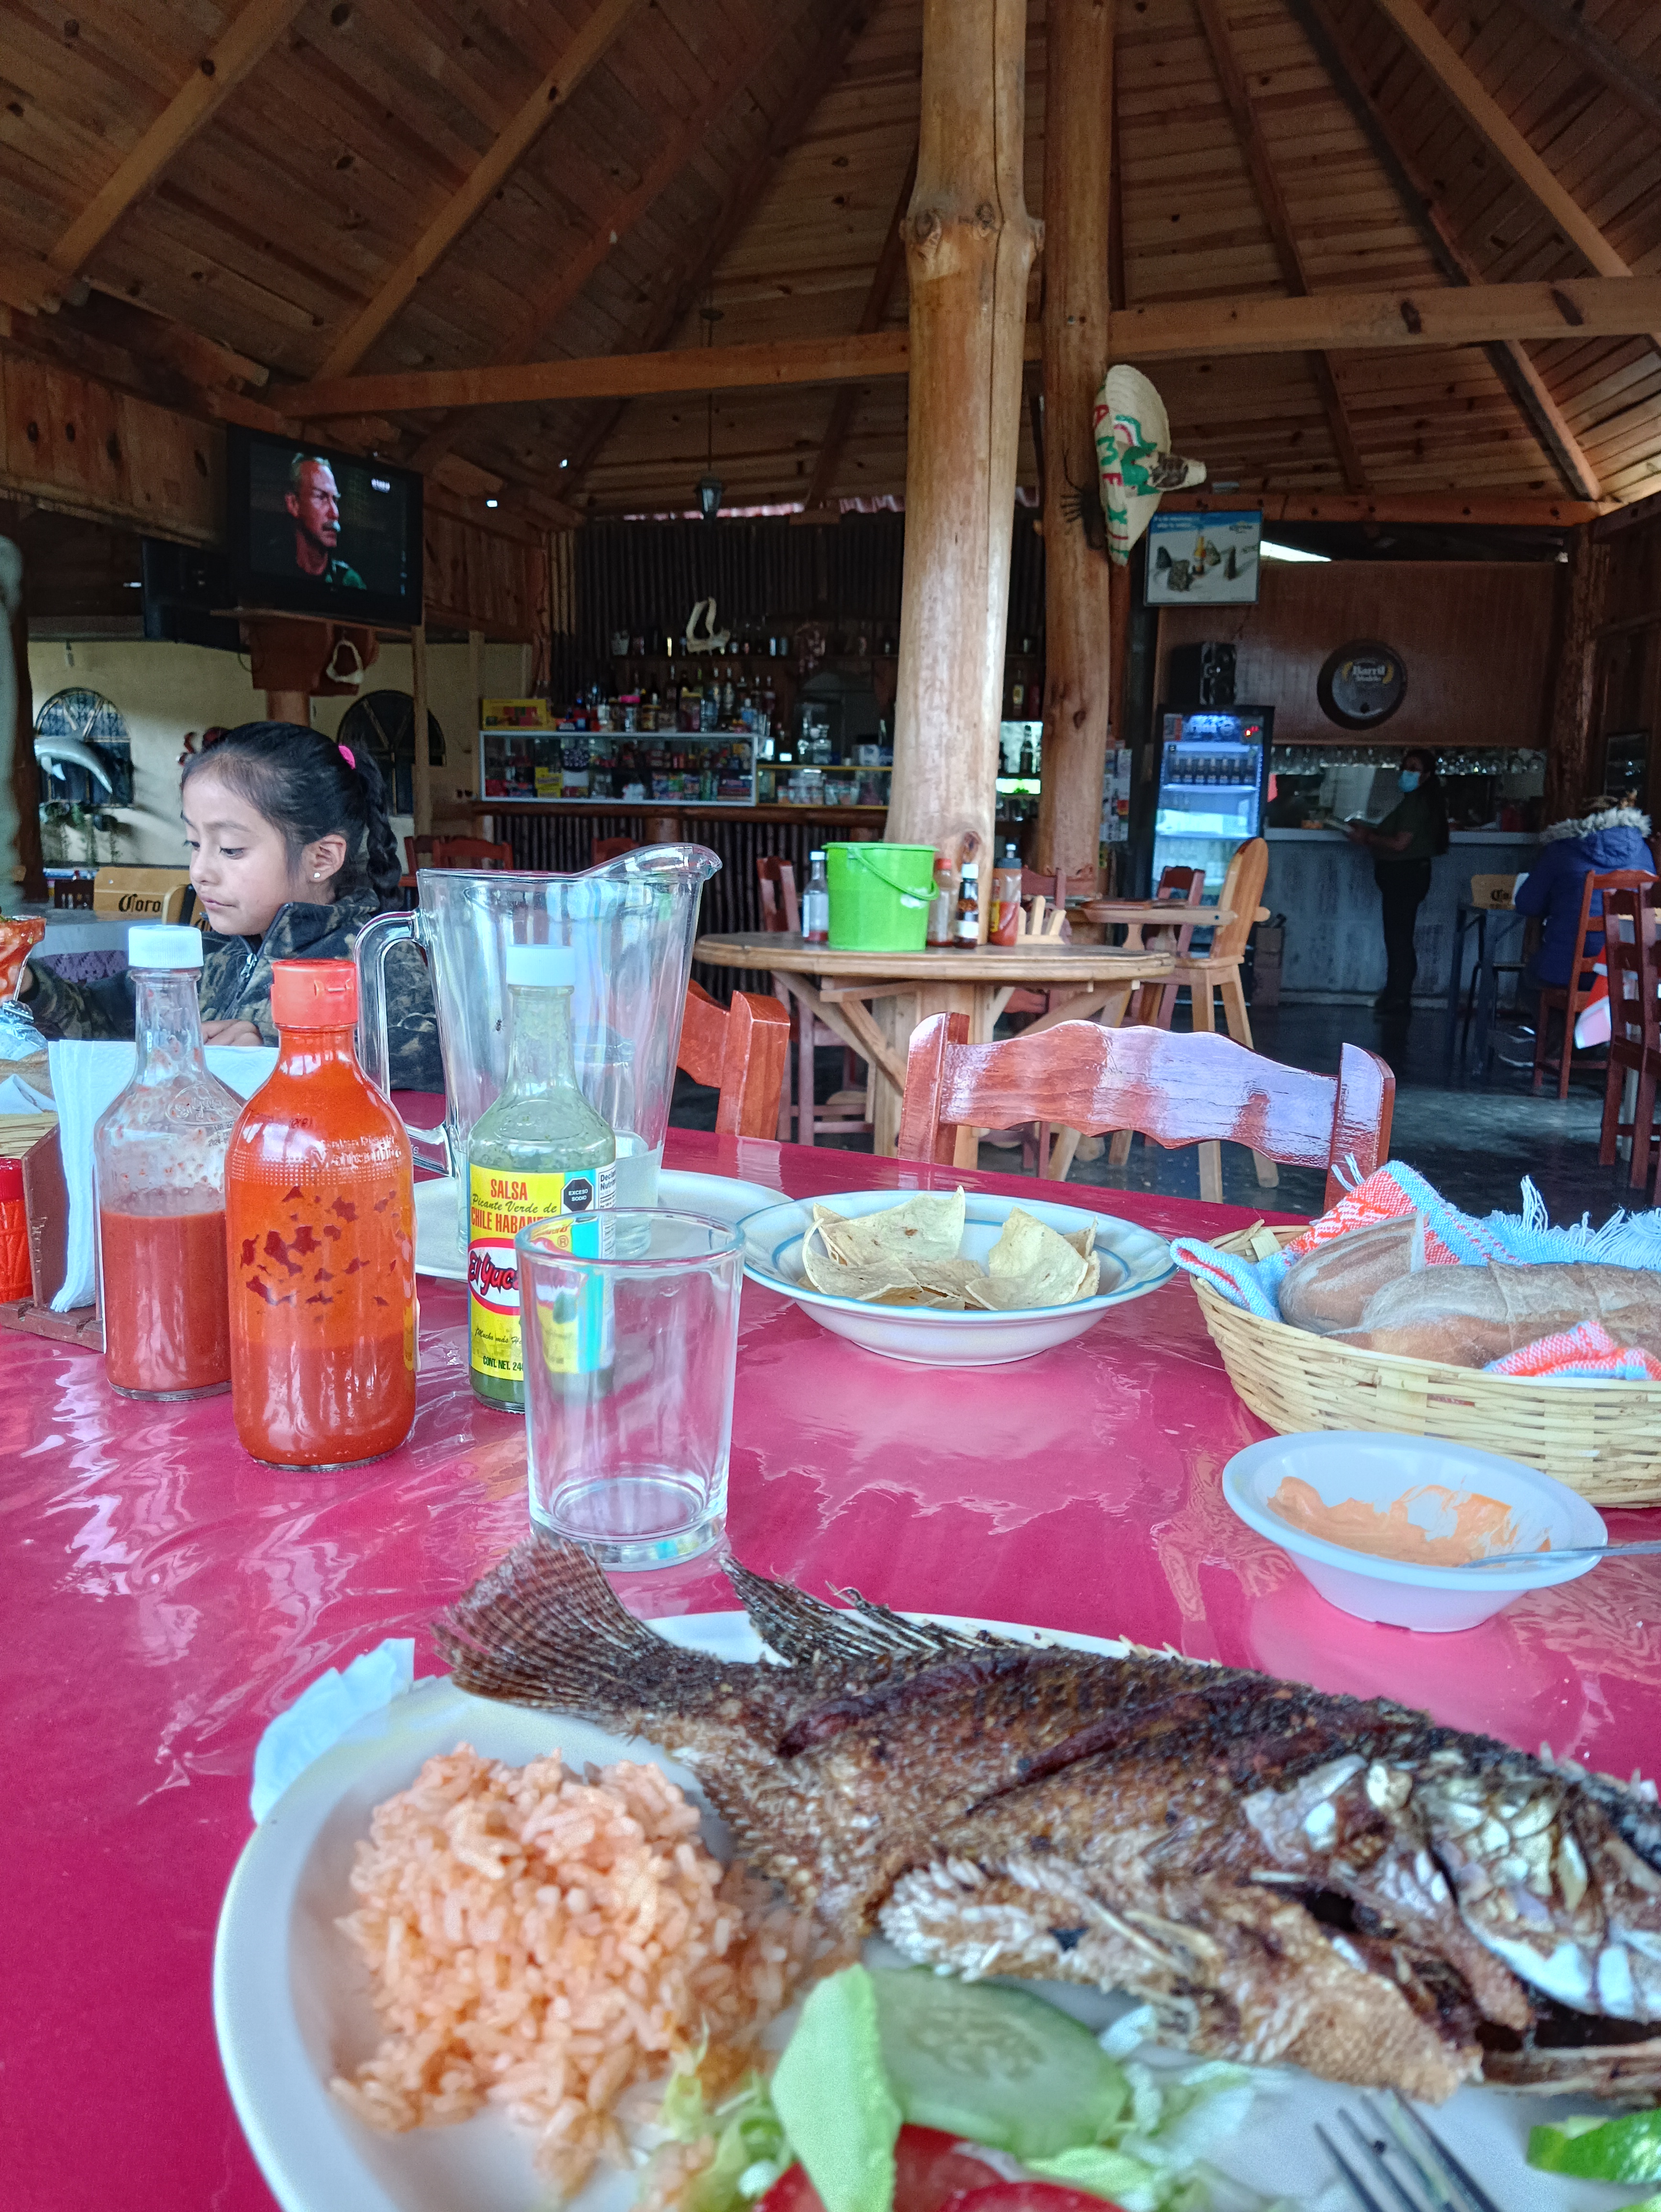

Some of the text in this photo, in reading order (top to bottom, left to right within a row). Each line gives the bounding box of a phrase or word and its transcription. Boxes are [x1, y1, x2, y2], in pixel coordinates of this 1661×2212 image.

[119, 894, 161, 912] Coro
[491, 1179, 528, 1201] SALSA
[472, 1194, 557, 1214] Picante Verde de
[471, 1206, 492, 1230] CHILE
[469, 1250, 482, 1286] El
[495, 1336, 509, 1344] más
[483, 1356, 497, 1369] CONT.
[498, 1359, 510, 1370] NET.
